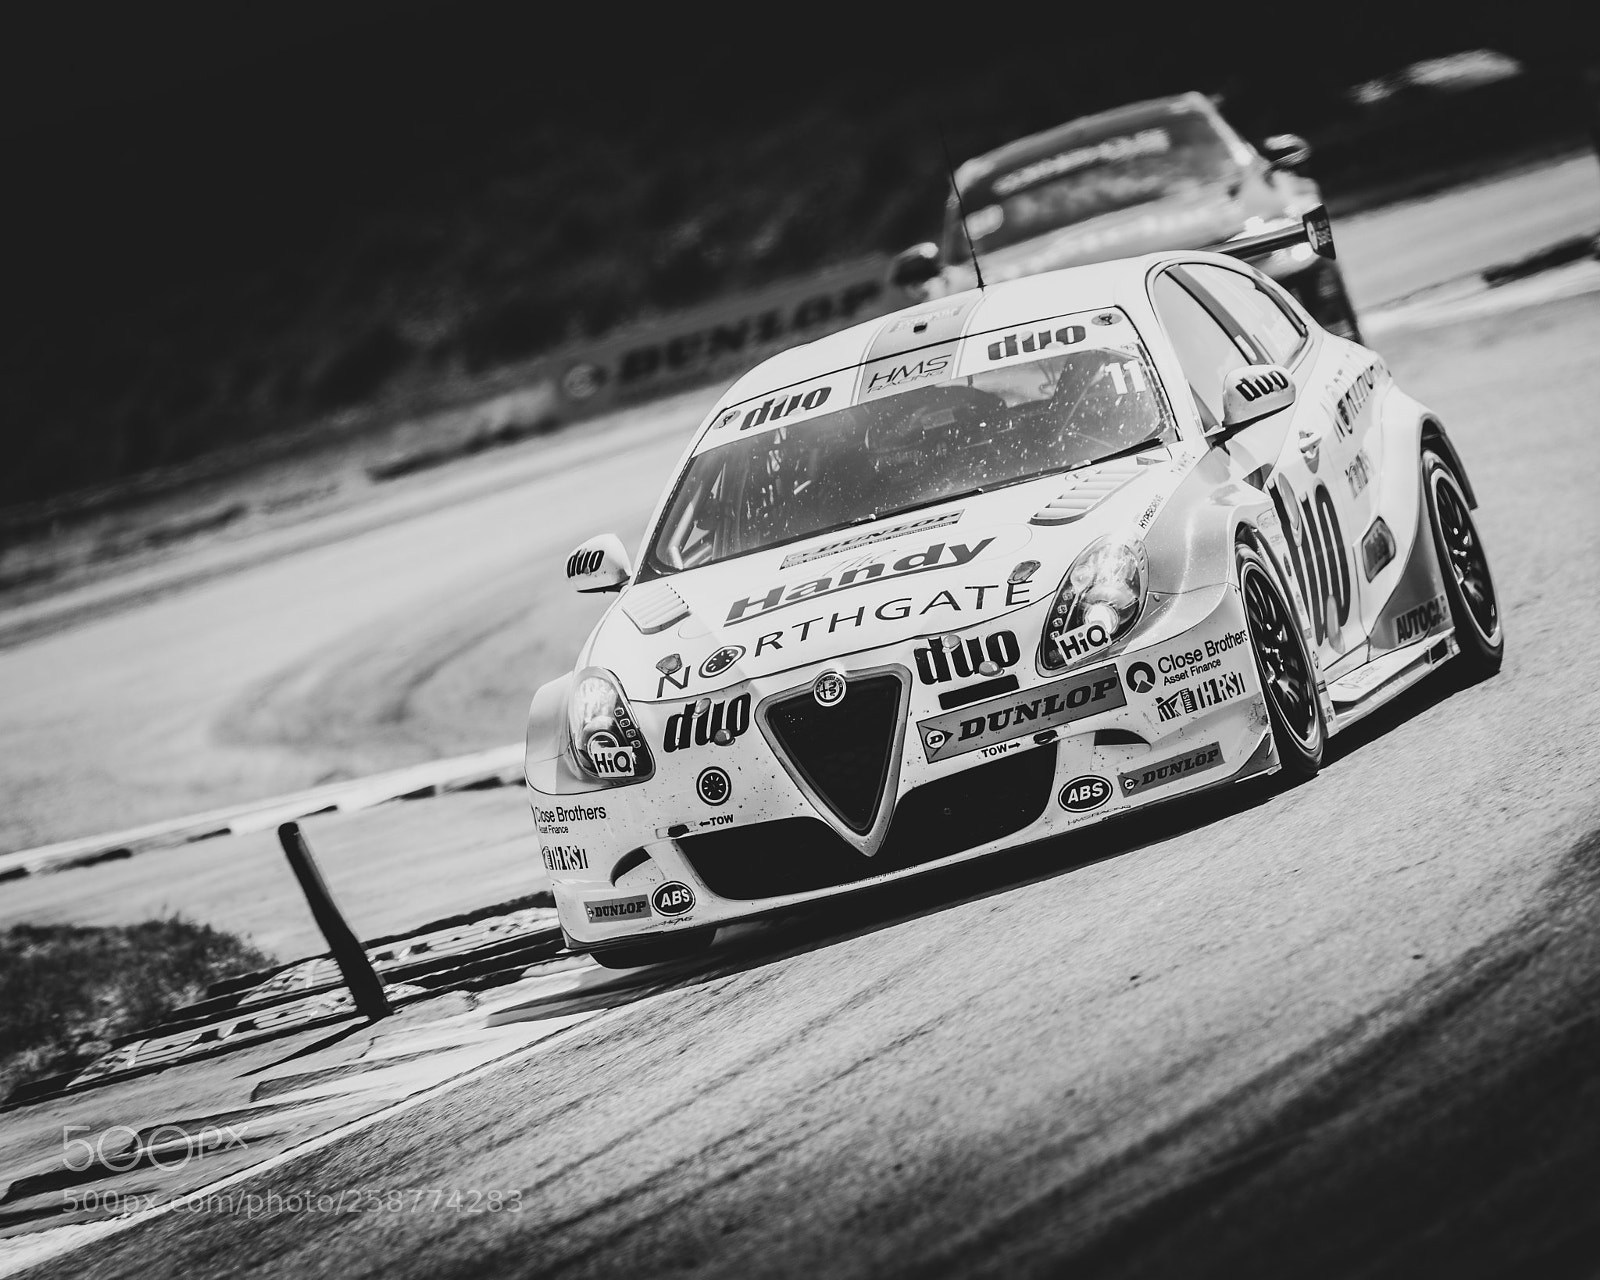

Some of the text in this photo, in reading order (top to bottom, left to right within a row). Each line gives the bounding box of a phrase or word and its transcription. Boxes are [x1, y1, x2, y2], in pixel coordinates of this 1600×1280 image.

[987, 325, 1086, 361] duo
[867, 354, 952, 389] HMS
[1104, 360, 1147, 395] 11
[1235, 370, 1288, 402] duo
[739, 386, 832, 431] duo
[566, 549, 604, 579] duo
[725, 536, 998, 623] Handy
[913, 629, 1021, 685] duo
[1059, 625, 1109, 660] HiQ
[1157, 648, 1203, 674] Close
[1163, 658, 1222, 687] Asset Finance
[663, 692, 752, 753] duo
[957, 676, 1118, 742] DUNLOP
[594, 751, 632, 773] HiQ
[981, 743, 1008, 758] TOW
[1141, 748, 1219, 786] DUNLOP
[1067, 782, 1104, 804] ABS
[556, 804, 607, 823] Brothers
[709, 814, 734, 826] TOW
[594, 900, 647, 917] DUNLOP
[660, 888, 690, 908] ABS
